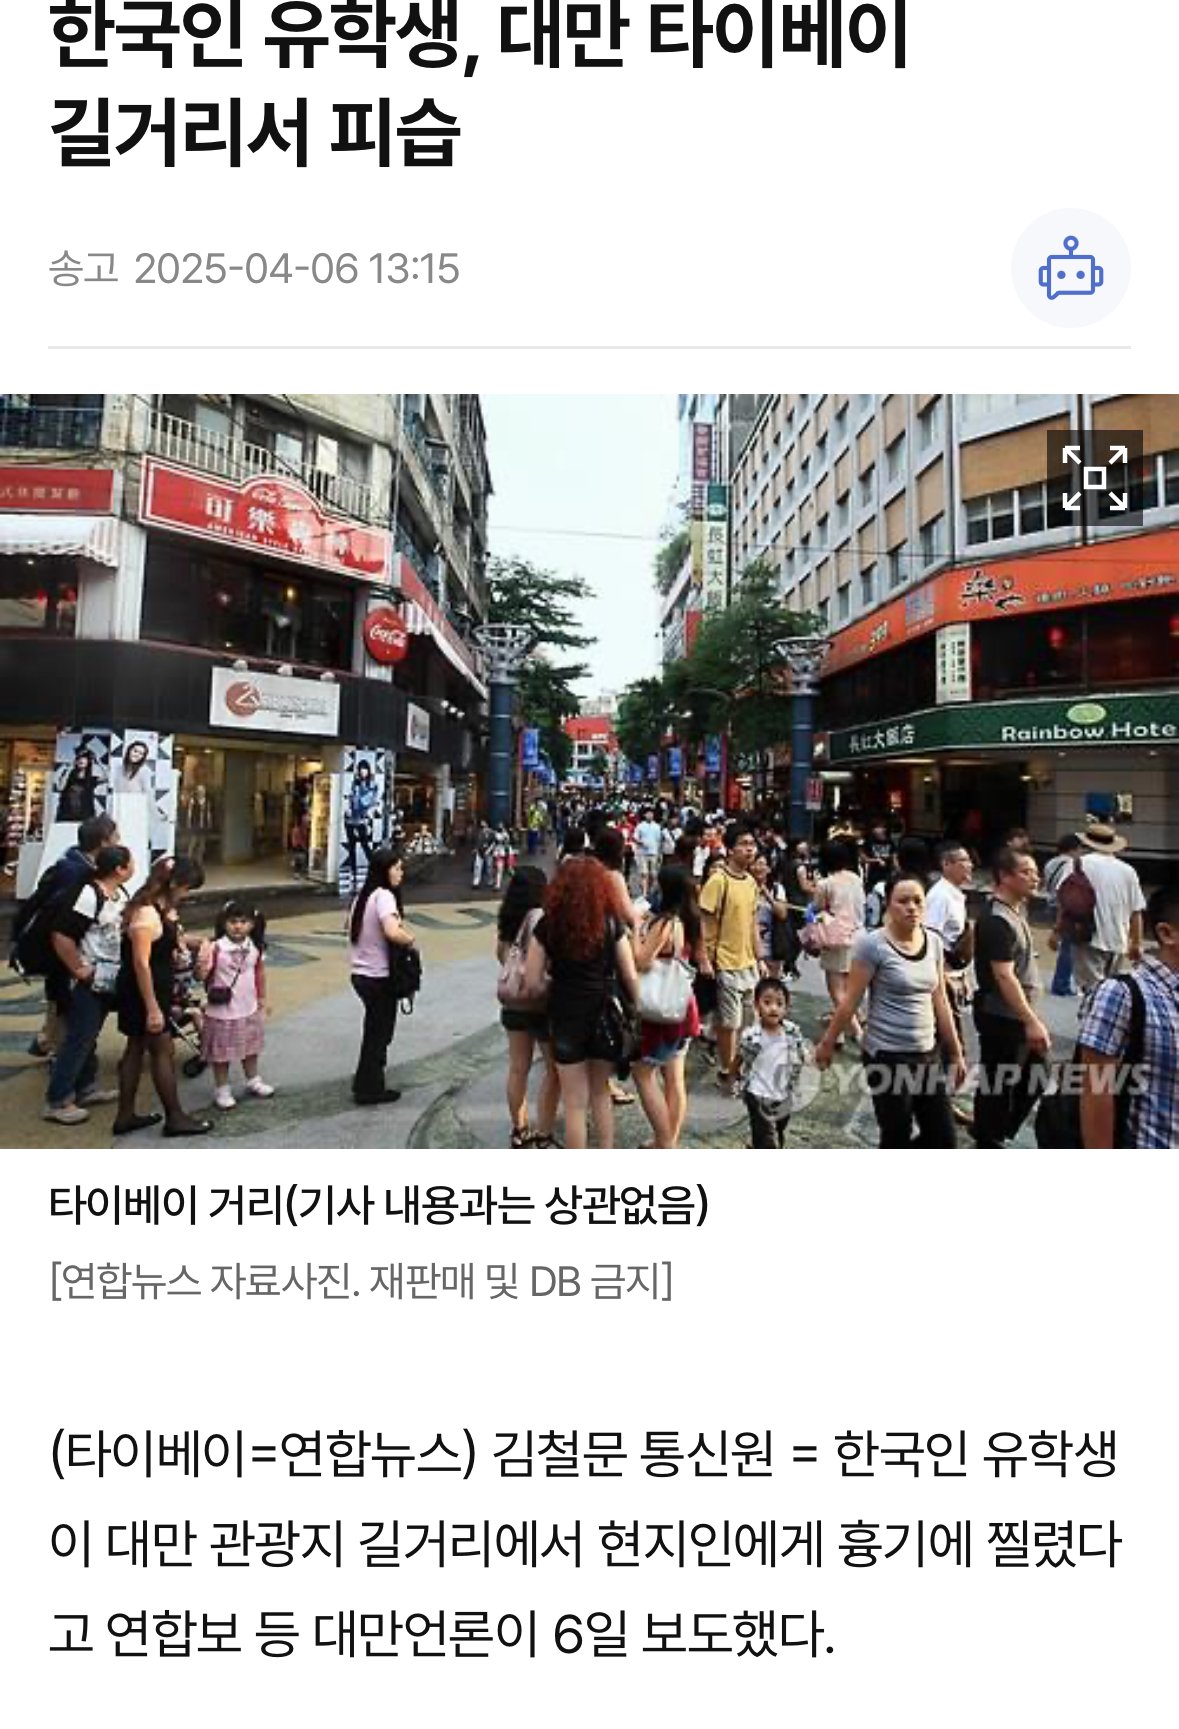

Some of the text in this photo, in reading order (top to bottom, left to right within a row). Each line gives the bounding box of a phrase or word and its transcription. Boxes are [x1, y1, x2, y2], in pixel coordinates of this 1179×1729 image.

[50, 0, 905, 77] 한국인 유학생, 대만 타이베이
[51, 98, 460, 167] 길거리서 피습
[49, 250, 459, 286] 송고 2025-04-06 13:15
[1001, 725, 1105, 742] Rainbow
[51, 1184, 707, 1226] 타이베이 거리(기사 내용과는 상관없음)
[51, 1261, 672, 1301] [연합뉴스 자료사진. 재판매 및 DB 금지]
[52, 1428, 1116, 1479] (타이베이=연합뉴스) 김철문 통신원 = 한국인 유학생
[51, 1520, 1122, 1568] 이 대만 관광지 길거리에서 현지인에게 흉기에 찔렸다
[50, 1610, 834, 1658] 고 연합보 등 대만언론이 6일 보도했다.
